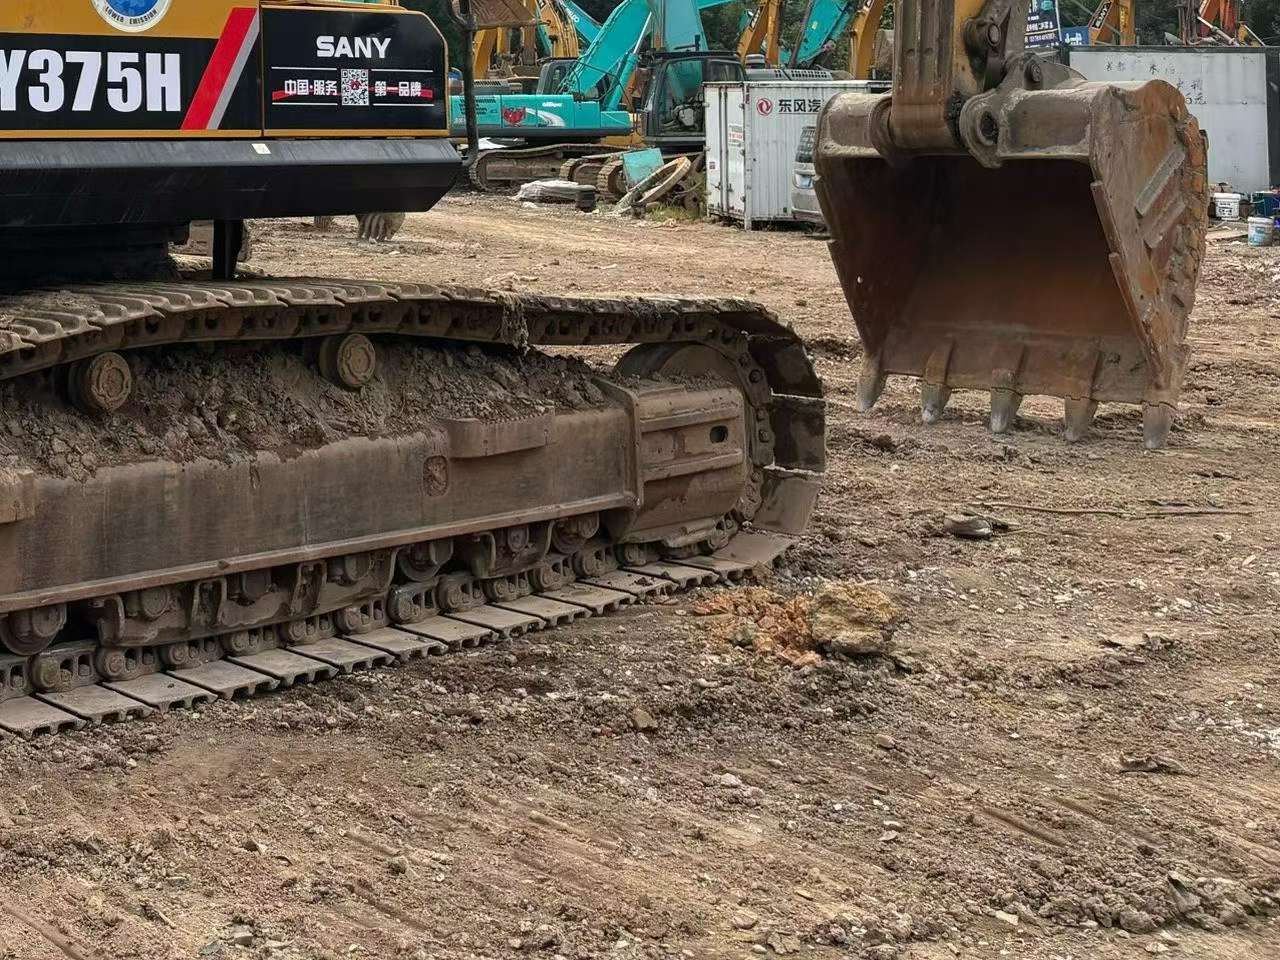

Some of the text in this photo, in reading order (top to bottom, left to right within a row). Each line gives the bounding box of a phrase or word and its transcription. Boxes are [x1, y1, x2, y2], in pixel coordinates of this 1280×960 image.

[104, 6, 158, 25] LOWER EMISSION
[316, 36, 392, 59] SANY
[374, 81, 422, 97] 第一品牌
